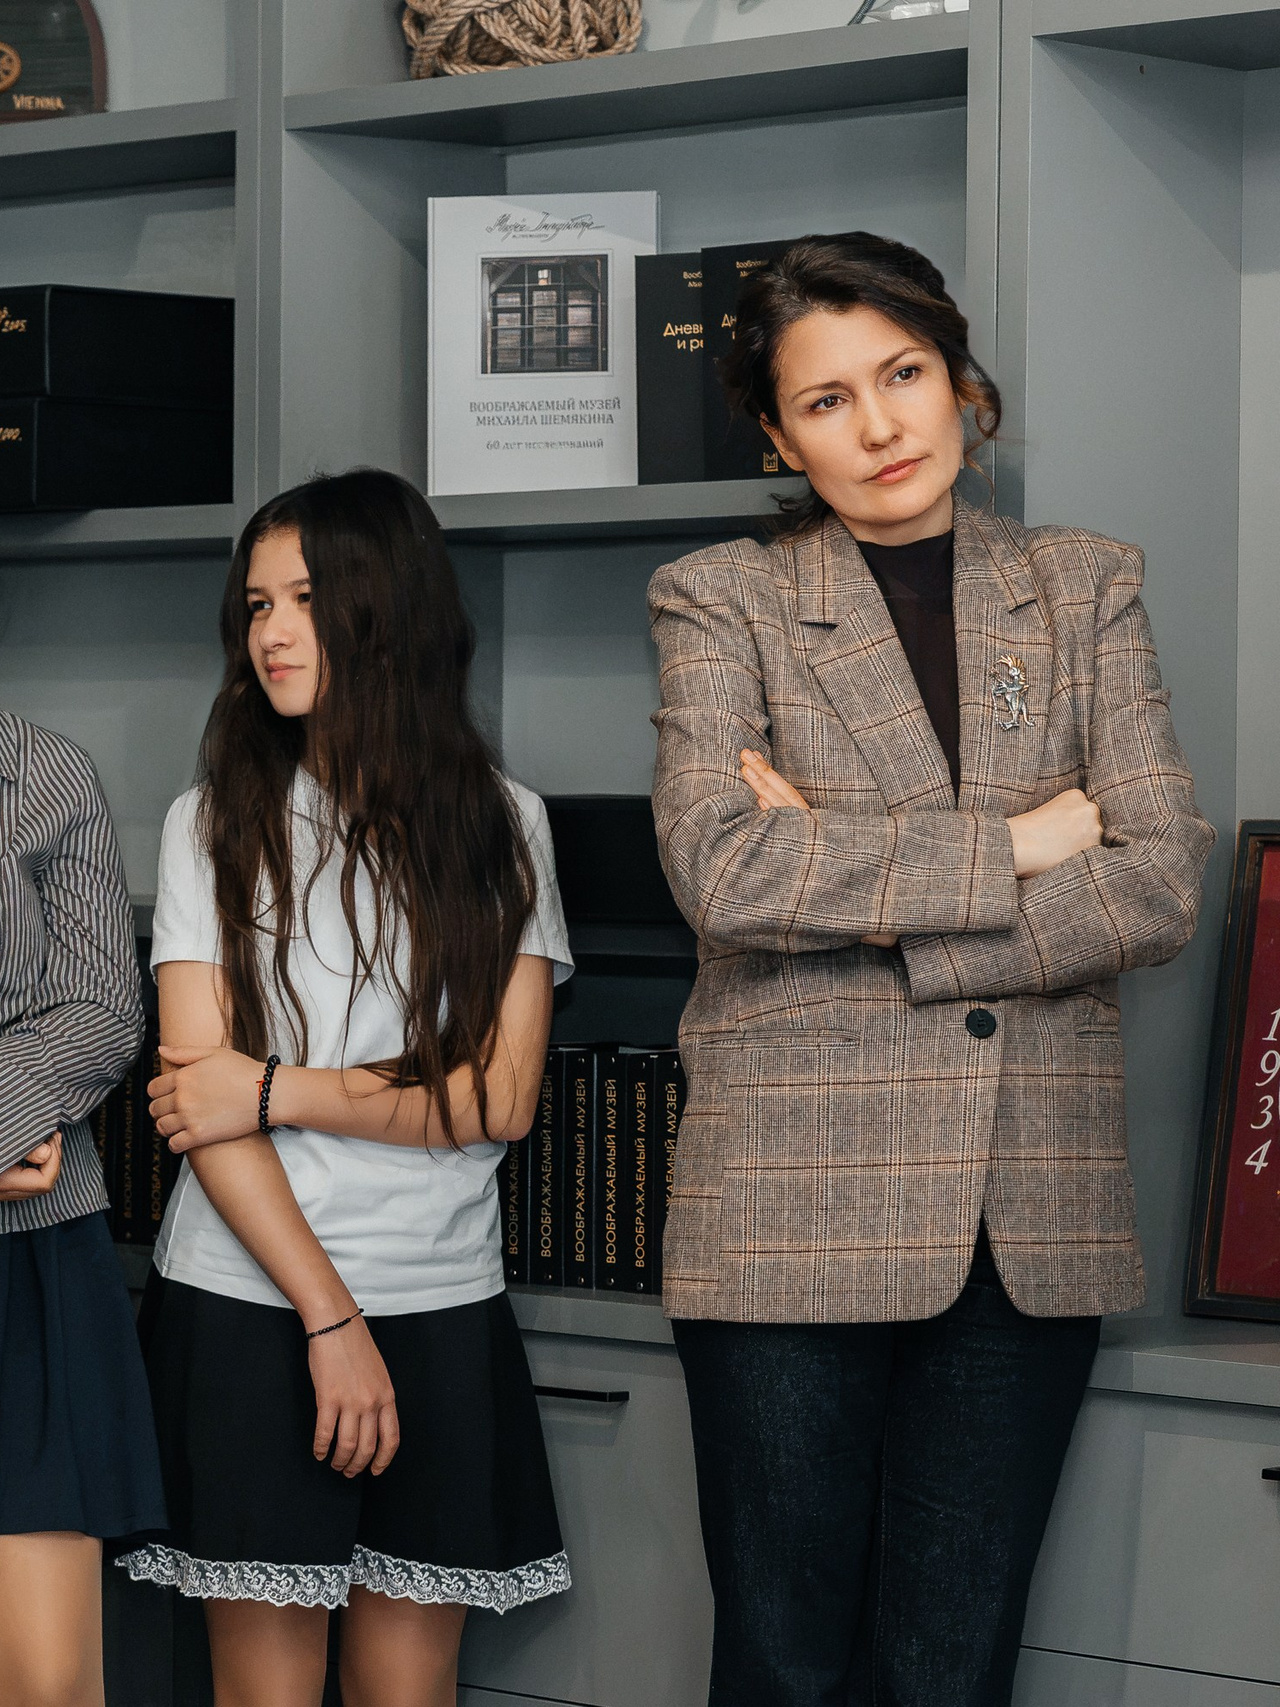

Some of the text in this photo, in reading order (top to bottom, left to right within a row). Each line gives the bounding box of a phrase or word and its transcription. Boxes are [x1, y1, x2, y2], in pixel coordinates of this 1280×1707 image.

[470, 397, 621, 412] ВООБРАЖАЕМЫЙ МУЗЕЙ
[476, 413, 614, 426] МИХАИЛА ШЕМЯКИНА
[540, 1074, 553, 1258] ВООБРАЖАЕМЫЙ МУЗЕЙ
[574, 1078, 586, 1263] ВООБРАЖАЕМЫЙ МУЗЕЙ
[605, 1079, 617, 1264] ВООБРАЖАЕМЫЙ МУЗЕЙ
[634, 1082, 646, 1268] ВООБРАЖАЕМЫЙ МУЗЕЙ
[665, 1083, 677, 1135] МУЗЕЙ
